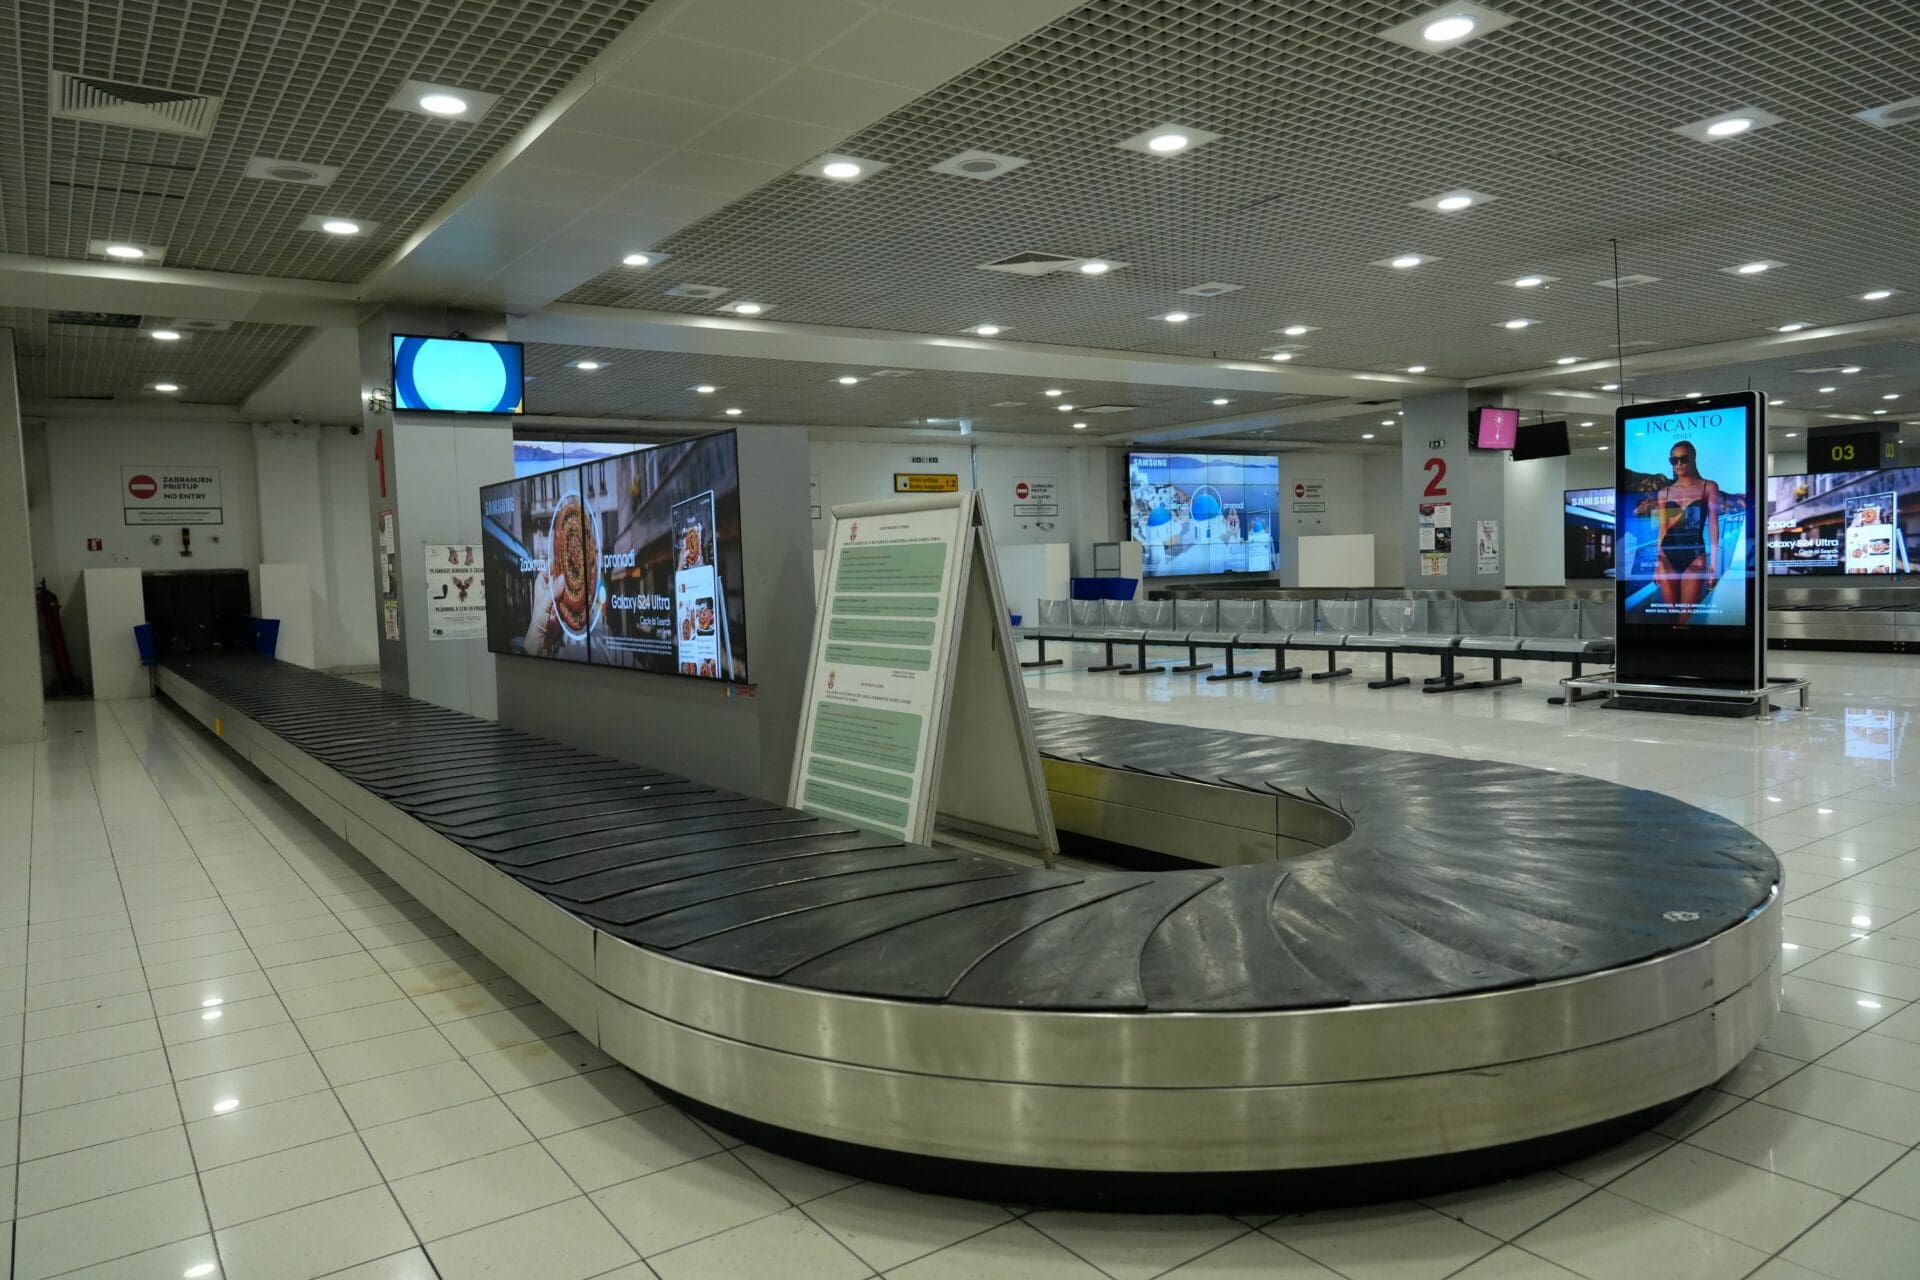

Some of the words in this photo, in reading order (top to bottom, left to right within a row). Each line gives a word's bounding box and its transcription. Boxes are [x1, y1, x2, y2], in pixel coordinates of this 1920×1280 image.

[1646, 414, 1723, 434] INCANTO
[1673, 432, 1693, 440] ITALY
[1831, 445, 1855, 461] 03
[1885, 443, 1894, 459] 03
[374, 429, 387, 498] 1
[1133, 458, 1167, 467] SAMSUNG
[1423, 457, 1447, 497] 2
[485, 496, 515, 516] SAMSUNG
[1571, 495, 1615, 507] SAMSUN
[1815, 538, 1839, 547] Ultra
[611, 593, 636, 613] Galaxy
[637, 595, 651, 610] S24
[651, 593, 671, 611] Ultra
